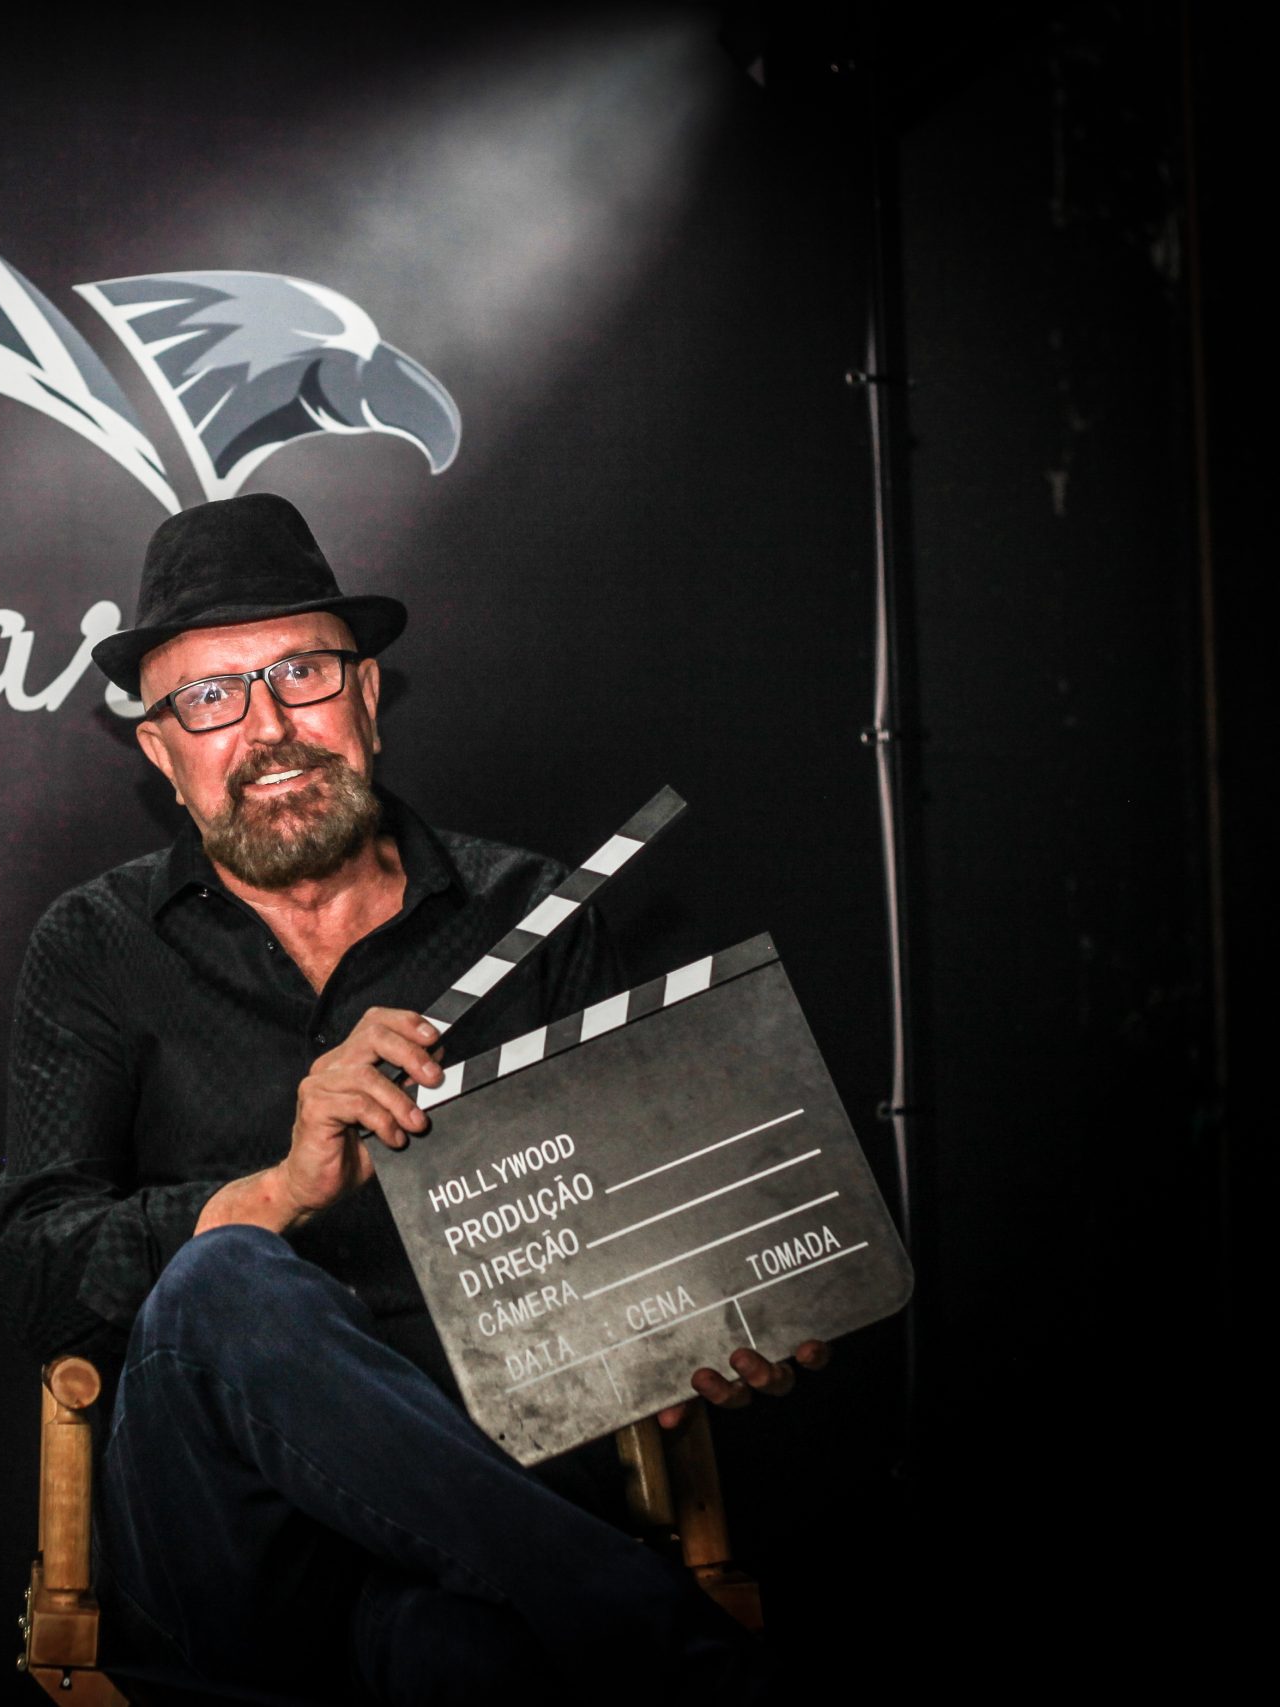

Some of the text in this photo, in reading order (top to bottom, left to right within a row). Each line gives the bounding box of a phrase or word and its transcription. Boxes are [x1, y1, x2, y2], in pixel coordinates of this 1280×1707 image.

[428, 1134, 575, 1213] HOLLYWOOD
[444, 1173, 594, 1256] PRODUÇÃO
[459, 1228, 580, 1298] DIREÇÃO
[478, 1279, 579, 1337] CÂMERA
[505, 1226, 841, 1381] DATA CENA TOMADA
